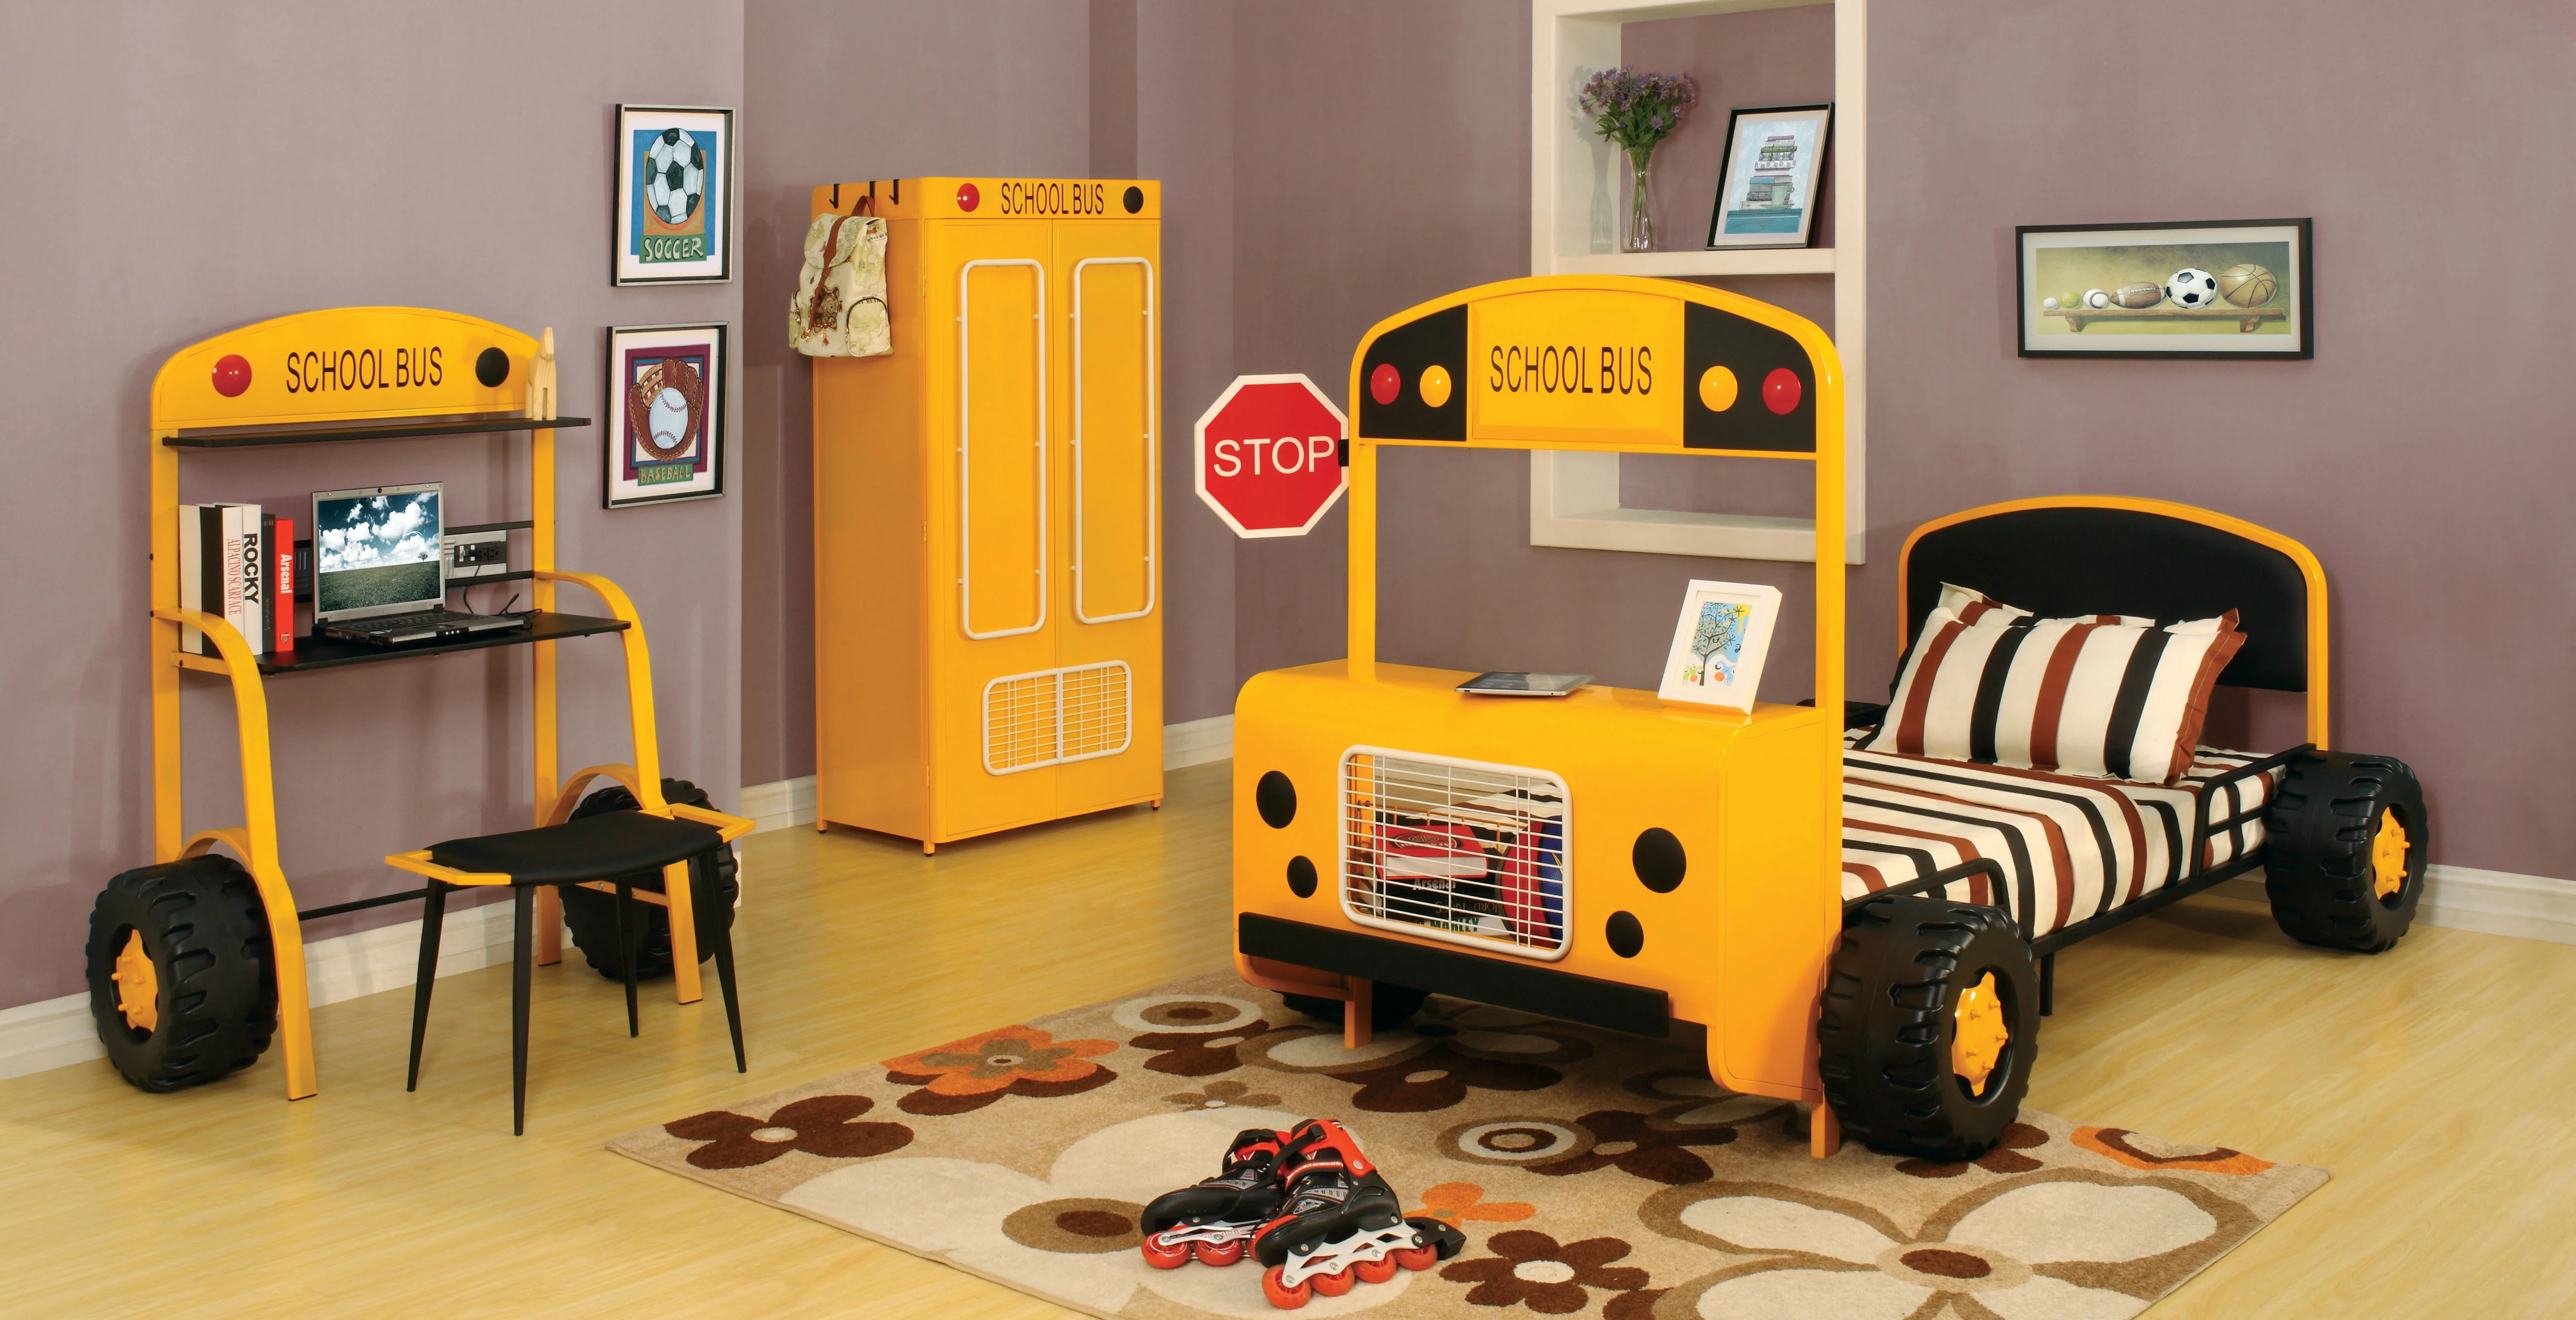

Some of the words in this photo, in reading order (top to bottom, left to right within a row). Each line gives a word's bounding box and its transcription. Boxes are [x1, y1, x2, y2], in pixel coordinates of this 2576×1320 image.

[1001, 182, 1069, 214] SCHOOL
[1073, 183, 1104, 215] BUS
[644, 237, 704, 262] SOCCER
[286, 349, 390, 393] SCHOOL
[396, 346, 442, 388] BUS
[1490, 345, 1593, 393] SCHOOL
[1601, 346, 1652, 395] BUS
[640, 465, 691, 483] BASEBALL
[1213, 435, 1335, 477] STOP
[244, 533, 259, 605] ROCKY
[280, 553, 292, 594] Arsenal
[228, 577, 242, 615] SCARFACE
